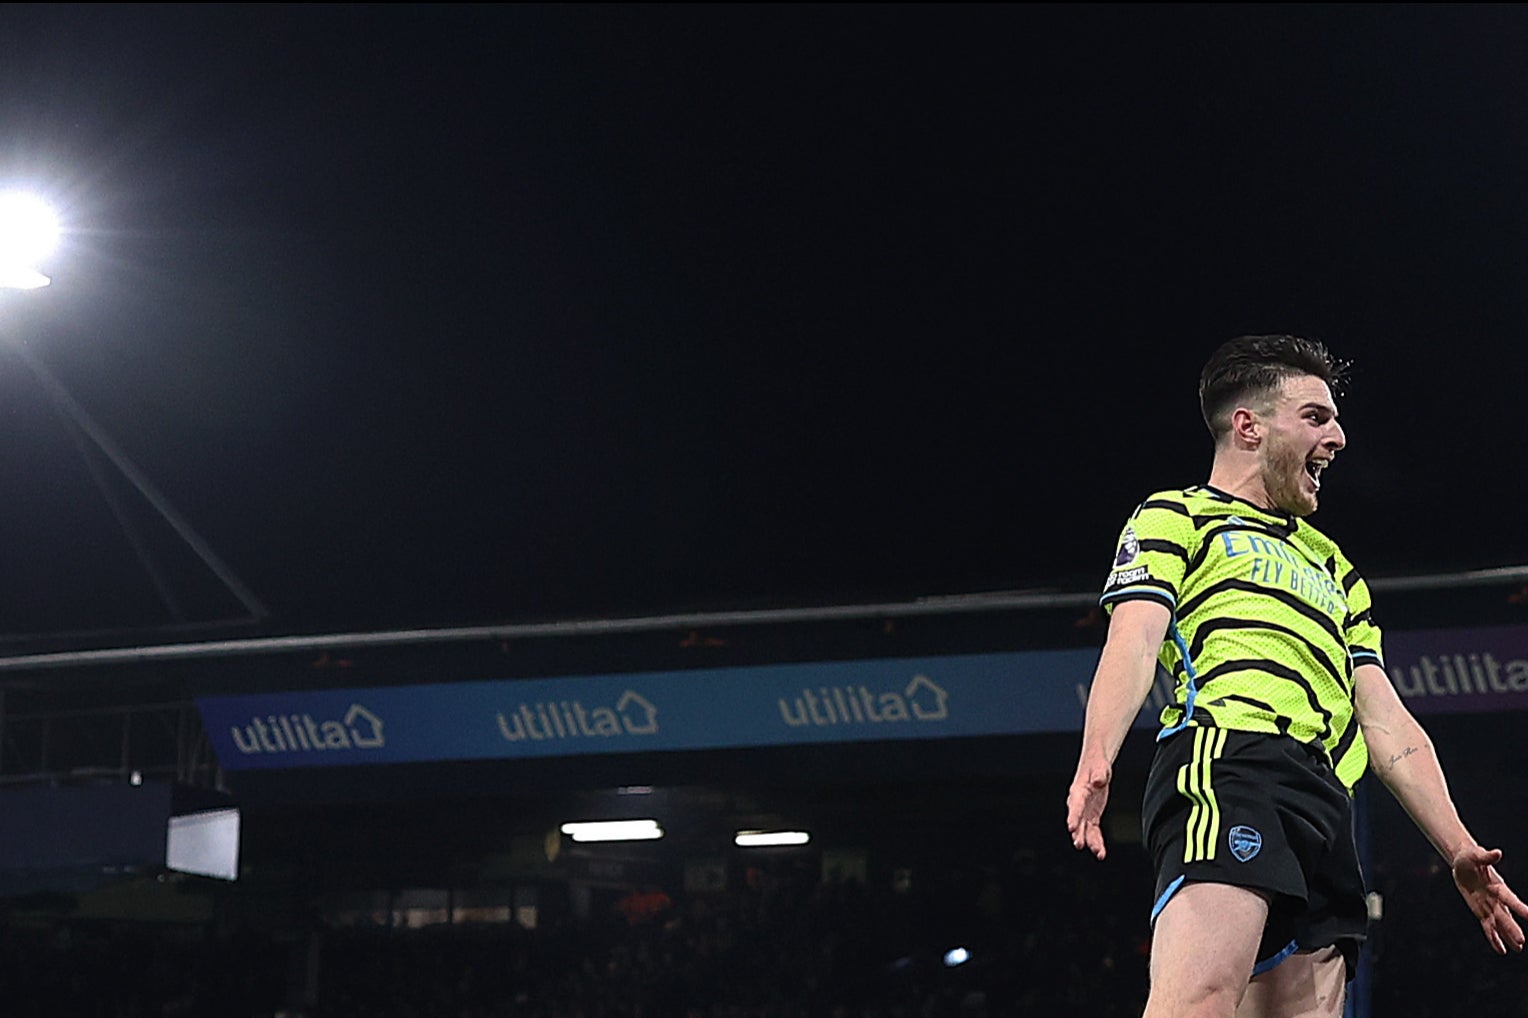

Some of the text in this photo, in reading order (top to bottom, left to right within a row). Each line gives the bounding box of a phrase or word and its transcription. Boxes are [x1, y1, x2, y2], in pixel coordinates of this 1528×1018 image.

[1251, 557, 1283, 584] FLY
[497, 701, 622, 741] utilita
[778, 686, 907, 726] utilita
[232, 713, 350, 754] utilita
